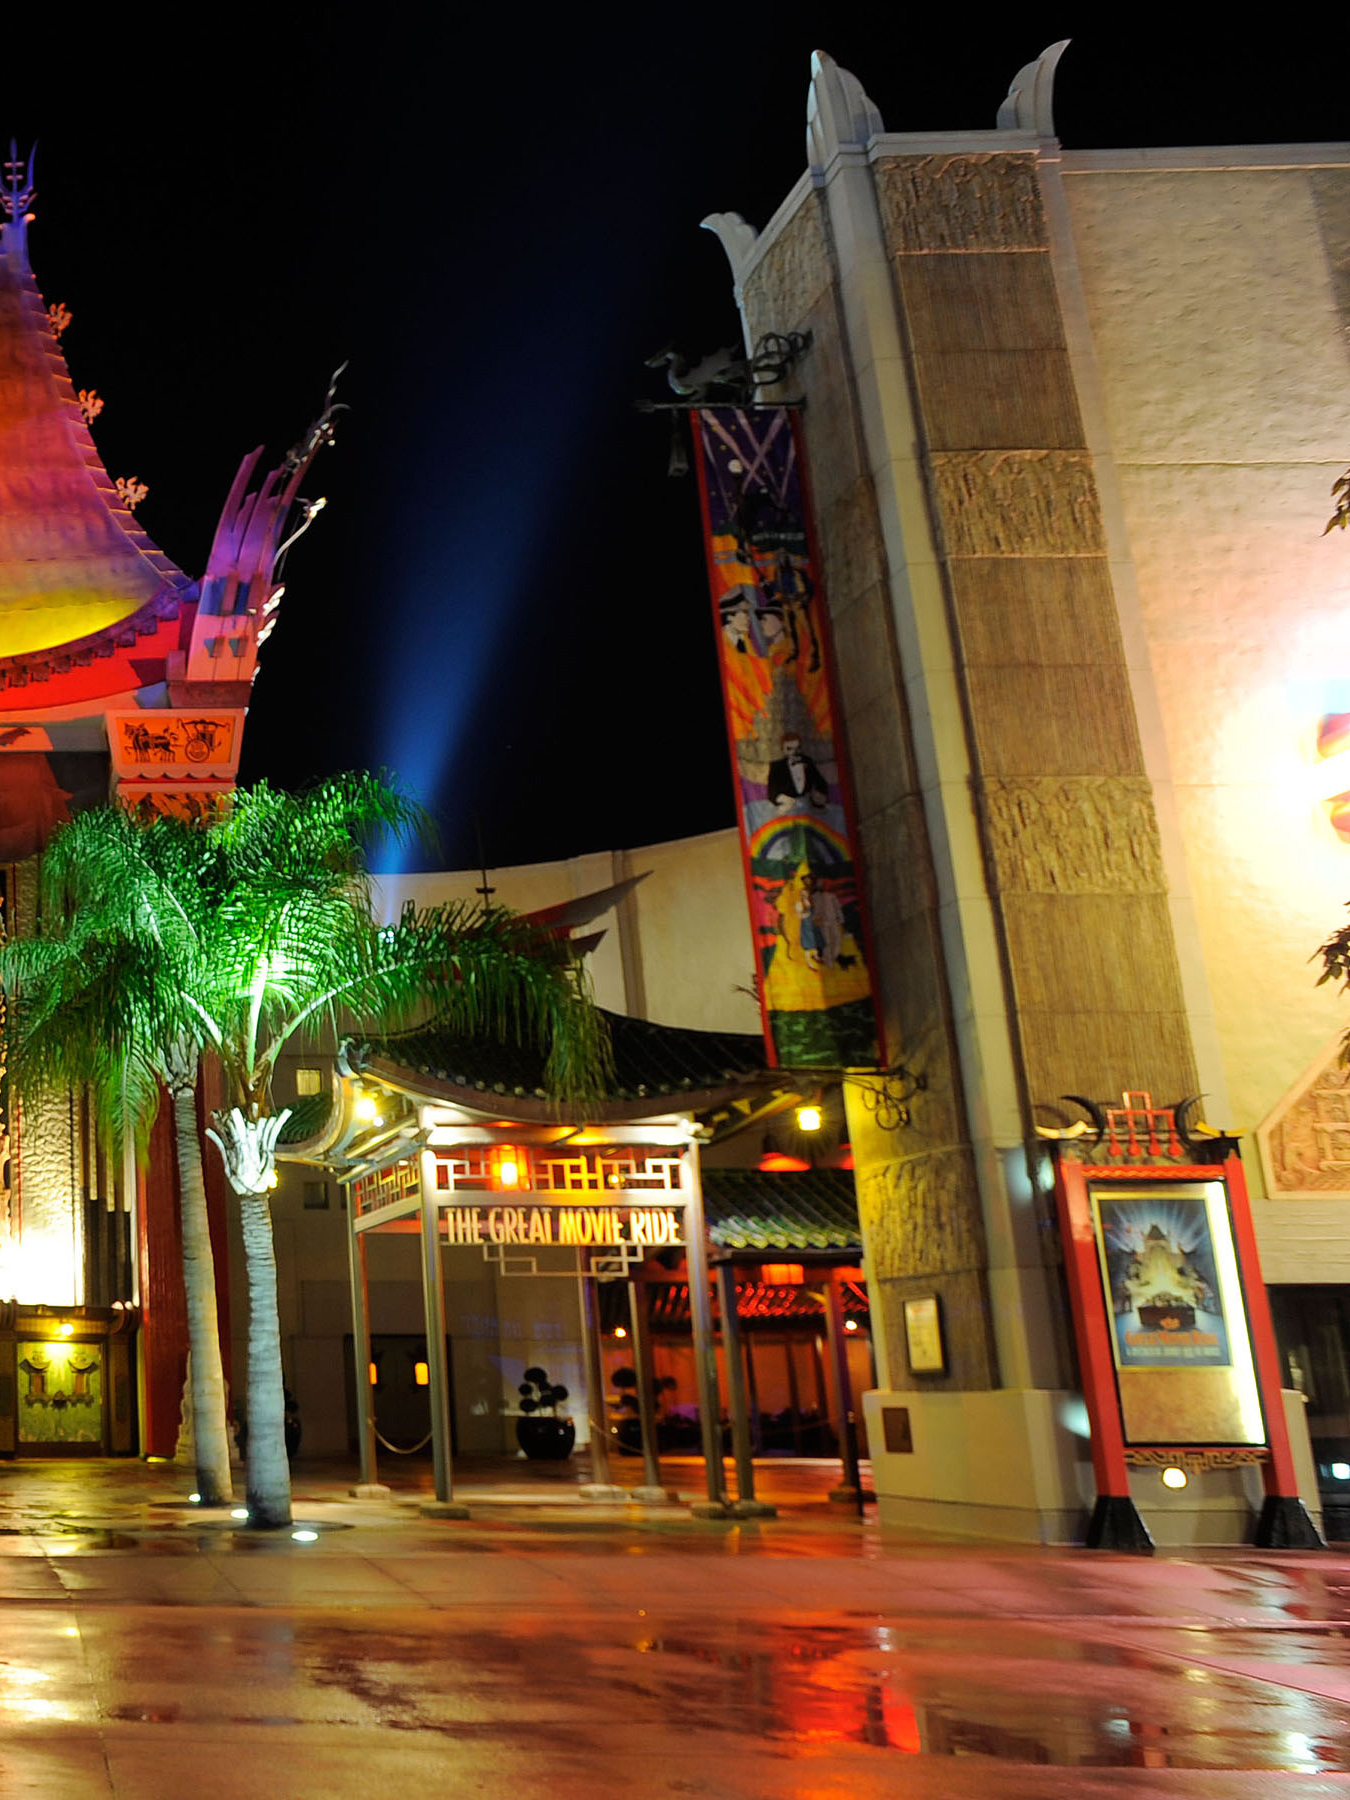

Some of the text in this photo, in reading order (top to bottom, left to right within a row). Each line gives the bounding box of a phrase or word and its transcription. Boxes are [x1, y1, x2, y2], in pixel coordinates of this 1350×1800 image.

[445, 1207, 682, 1244] THE GREAT MOVIE RIDE
